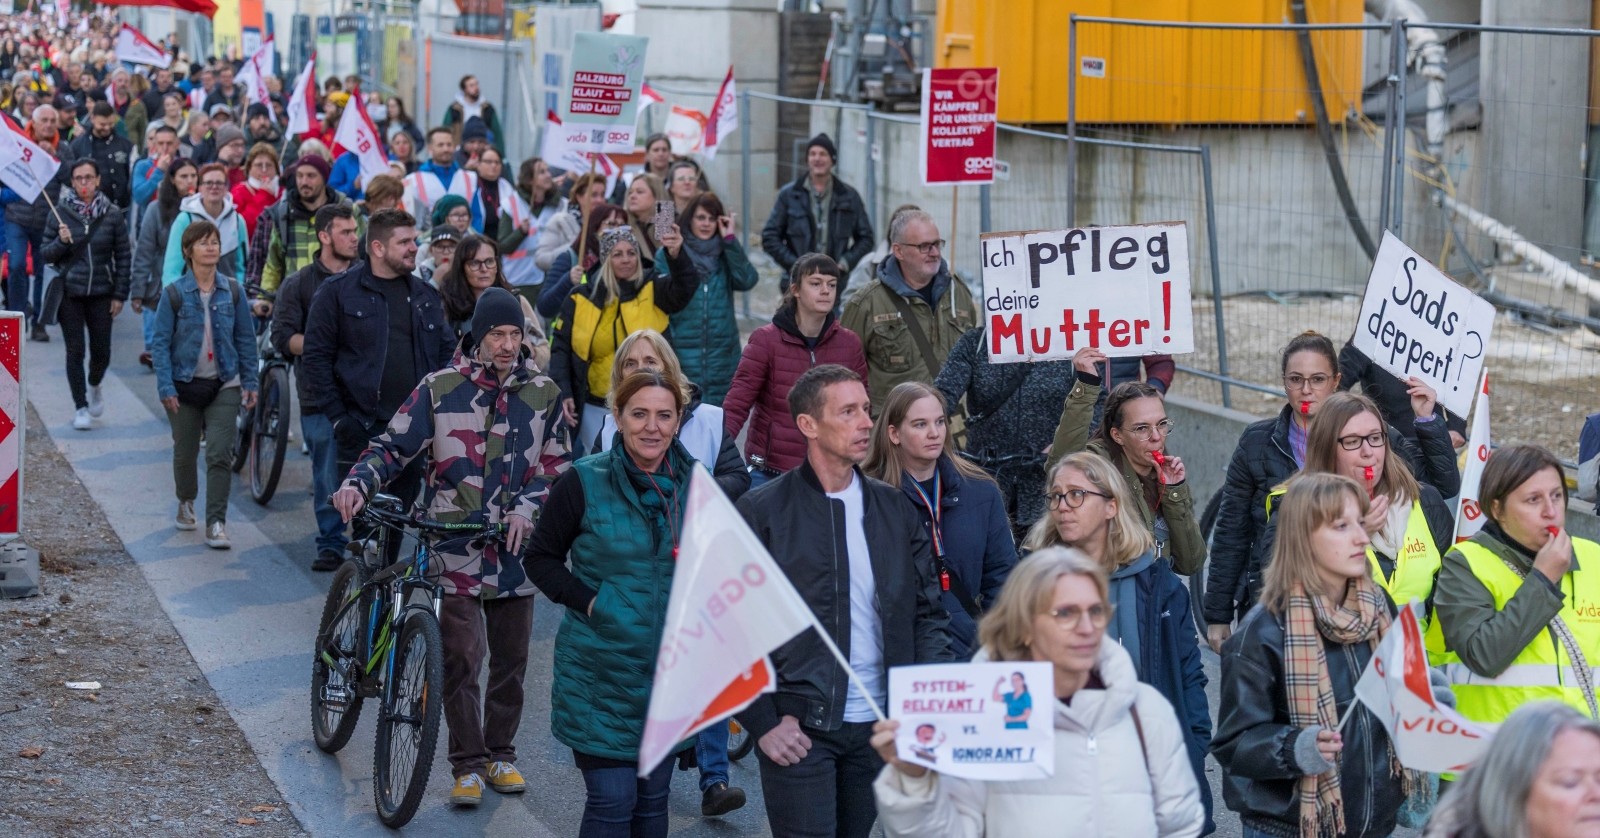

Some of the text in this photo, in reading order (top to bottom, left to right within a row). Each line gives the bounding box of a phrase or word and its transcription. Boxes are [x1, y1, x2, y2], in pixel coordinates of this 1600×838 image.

[575, 73, 624, 85] SALZBURG
[573, 88, 604, 97] KLAUT
[613, 90, 630, 99] WIR
[934, 90, 953, 100] WIR
[571, 102, 620, 113] SIND LAUT!
[933, 101, 979, 112] KÄMPFEN
[933, 113, 996, 124] FÜR UNSEREN
[932, 125, 986, 136] KOLLEKTIV-
[566, 132, 629, 143] vida gpa
[931, 137, 974, 148] VERTRAG
[964, 156, 994, 174] gpa
[982, 229, 1171, 288] Ich pfleg
[986, 287, 1039, 312] deine
[1392, 256, 1459, 336] Sads
[1405, 537, 1426, 553] vida
[912, 681, 975, 693] SYSTEM-
